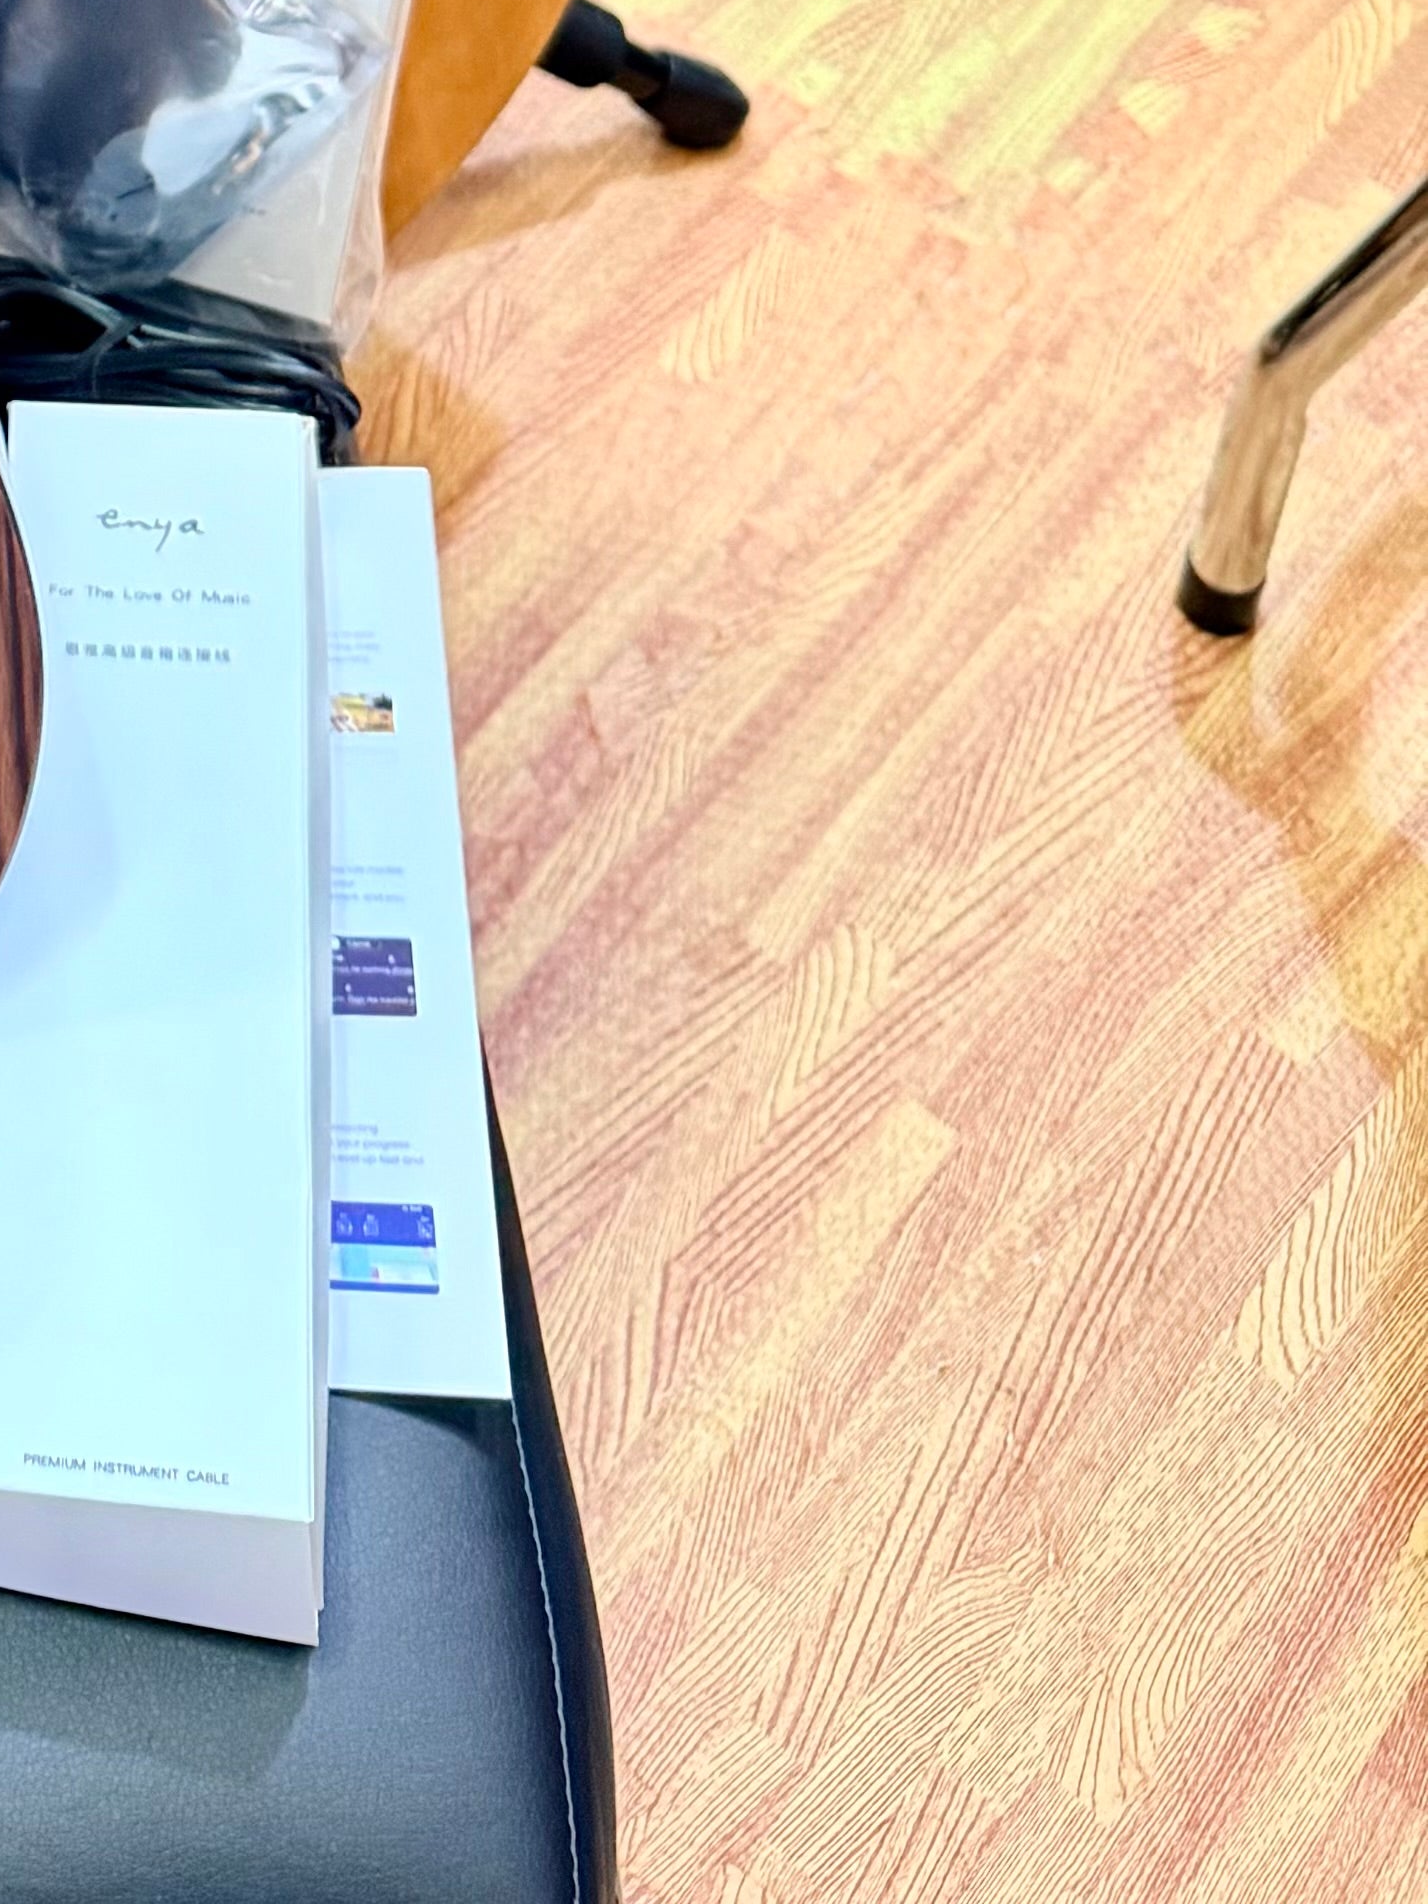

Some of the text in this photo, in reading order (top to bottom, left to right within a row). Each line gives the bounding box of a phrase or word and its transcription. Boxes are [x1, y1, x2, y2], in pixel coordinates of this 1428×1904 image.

[95, 508, 205, 553] enya
[48, 582, 251, 605] For The Love Of Music
[23, 1452, 230, 1486] PREMIUM INSTRUMENT CABLE
